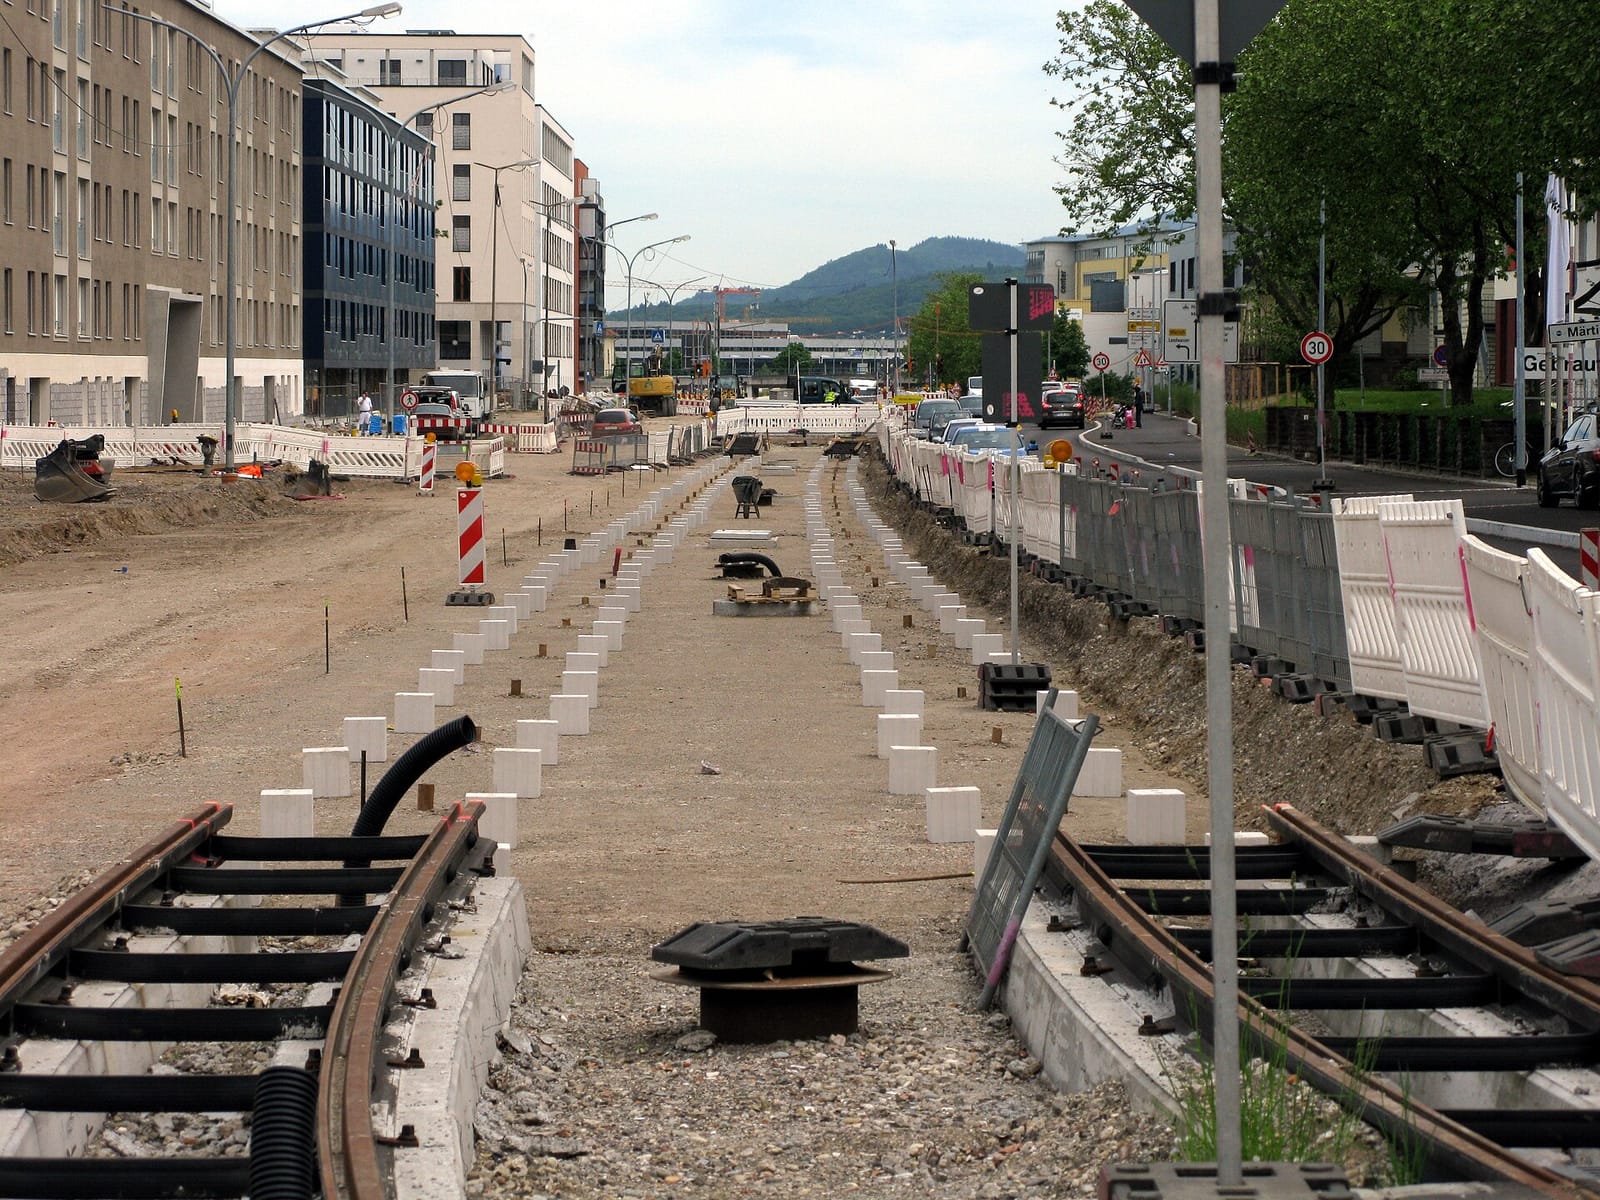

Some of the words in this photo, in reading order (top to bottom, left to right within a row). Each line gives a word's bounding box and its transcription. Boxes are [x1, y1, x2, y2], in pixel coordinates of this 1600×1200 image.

[1567, 325, 1600, 337] Märti
[1308, 341, 1325, 355] 30
[1096, 357, 1107, 366] 30
[1524, 354, 1600, 372] Gebrau
